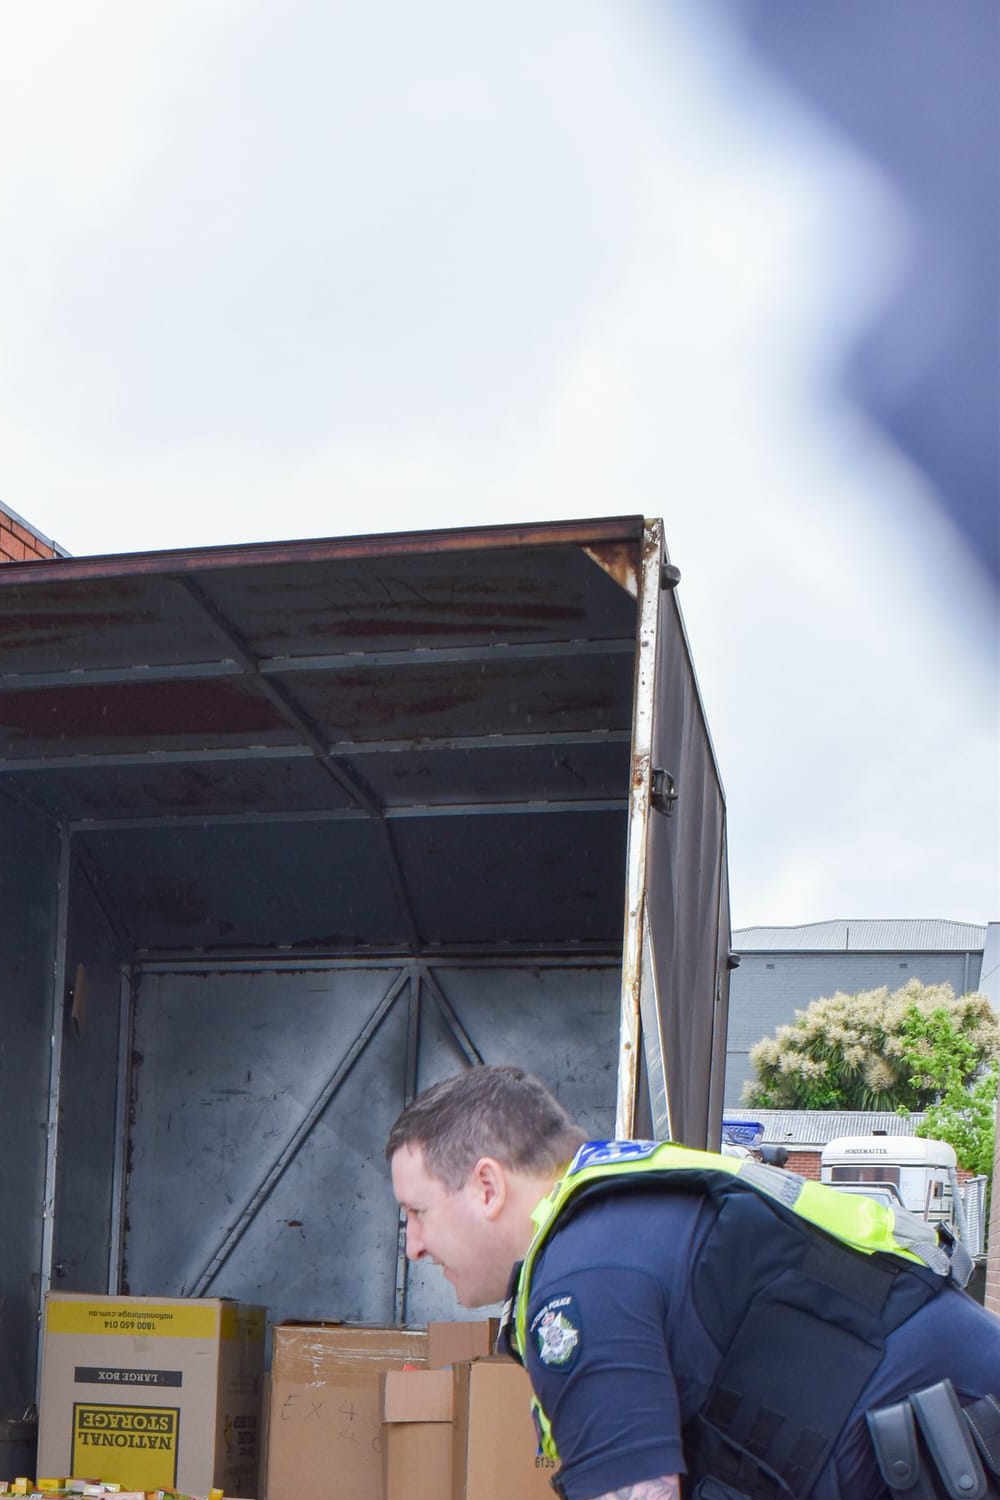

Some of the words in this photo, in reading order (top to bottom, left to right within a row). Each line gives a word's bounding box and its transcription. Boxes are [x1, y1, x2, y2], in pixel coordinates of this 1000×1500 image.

[88, 1310, 174, 1320] nationalstorage.com.au
[104, 1320, 119, 1329] 014
[119, 1321, 135, 1330] 650
[137, 1322, 156, 1331] 1800
[98, 1371, 122, 1381] BOX
[122, 1372, 158, 1382] LARGE
[83, 1412, 169, 1431] STORAGE
[78, 1431, 172, 1450] NATIONAL
[535, 1456, 555, 1468] 6135
